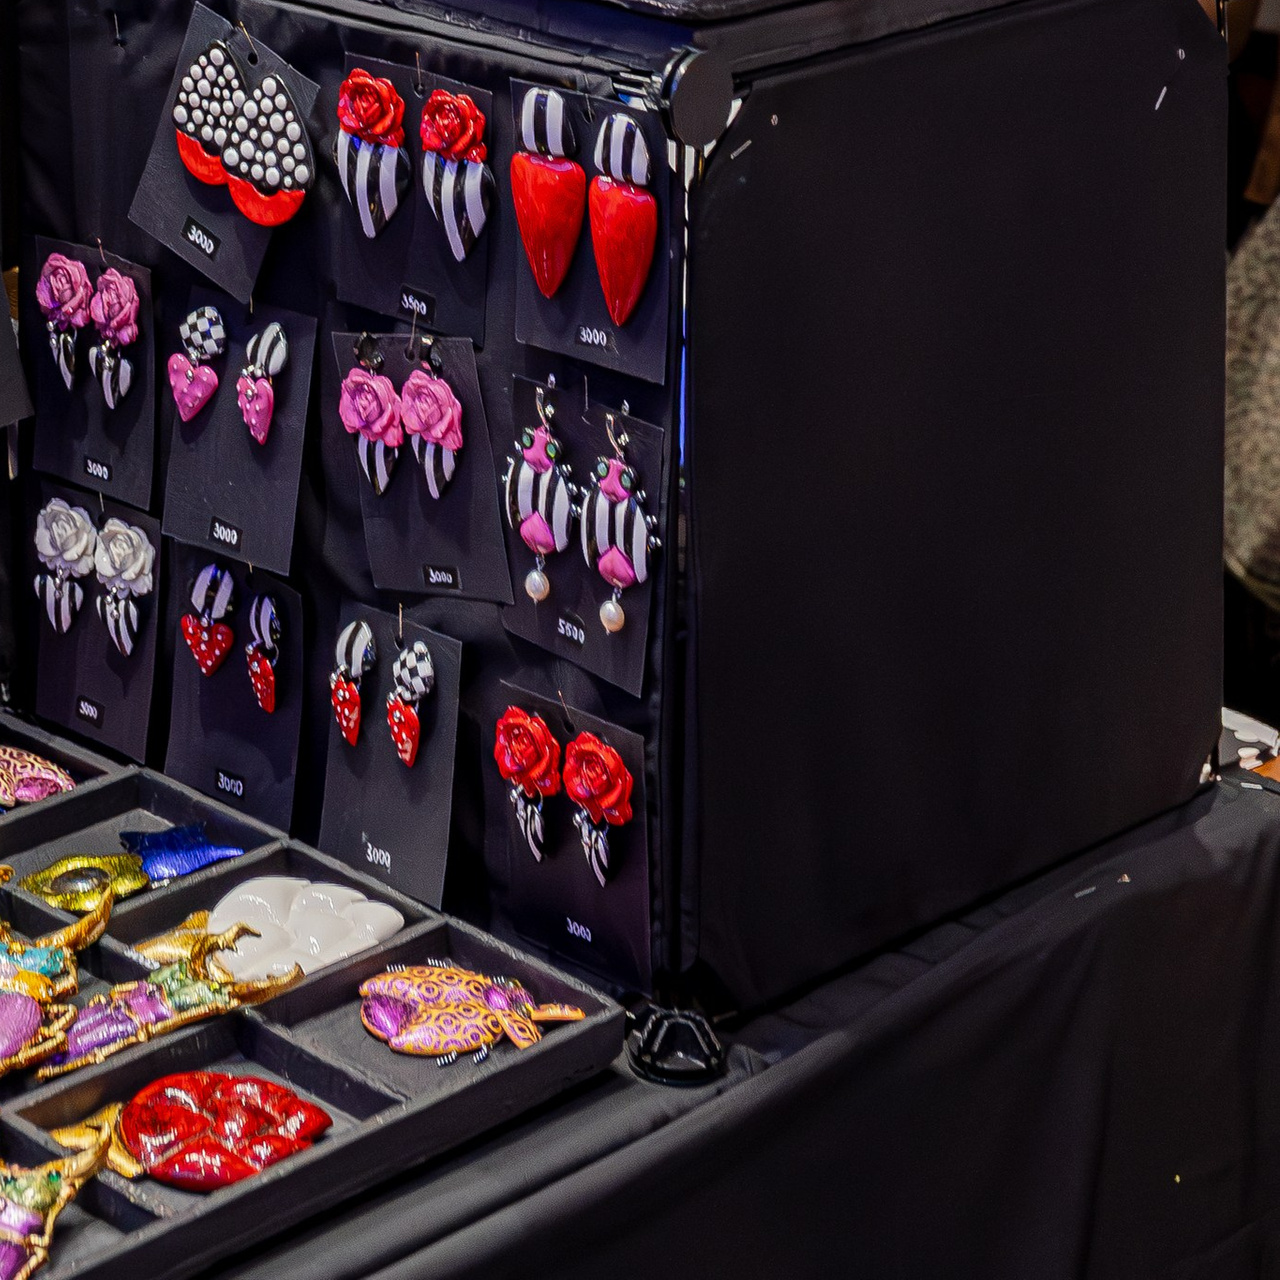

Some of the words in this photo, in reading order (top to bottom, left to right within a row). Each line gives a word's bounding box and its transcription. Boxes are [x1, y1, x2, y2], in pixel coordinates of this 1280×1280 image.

[187, 224, 215, 254] 3000
[579, 326, 607, 347] 3000
[86, 458, 109, 481] 3000
[212, 522, 238, 545] 3000
[428, 566, 453, 584] 3000
[217, 771, 244, 797] 3000
[366, 841, 391, 868] 3000
[566, 916, 592, 943] 3000
